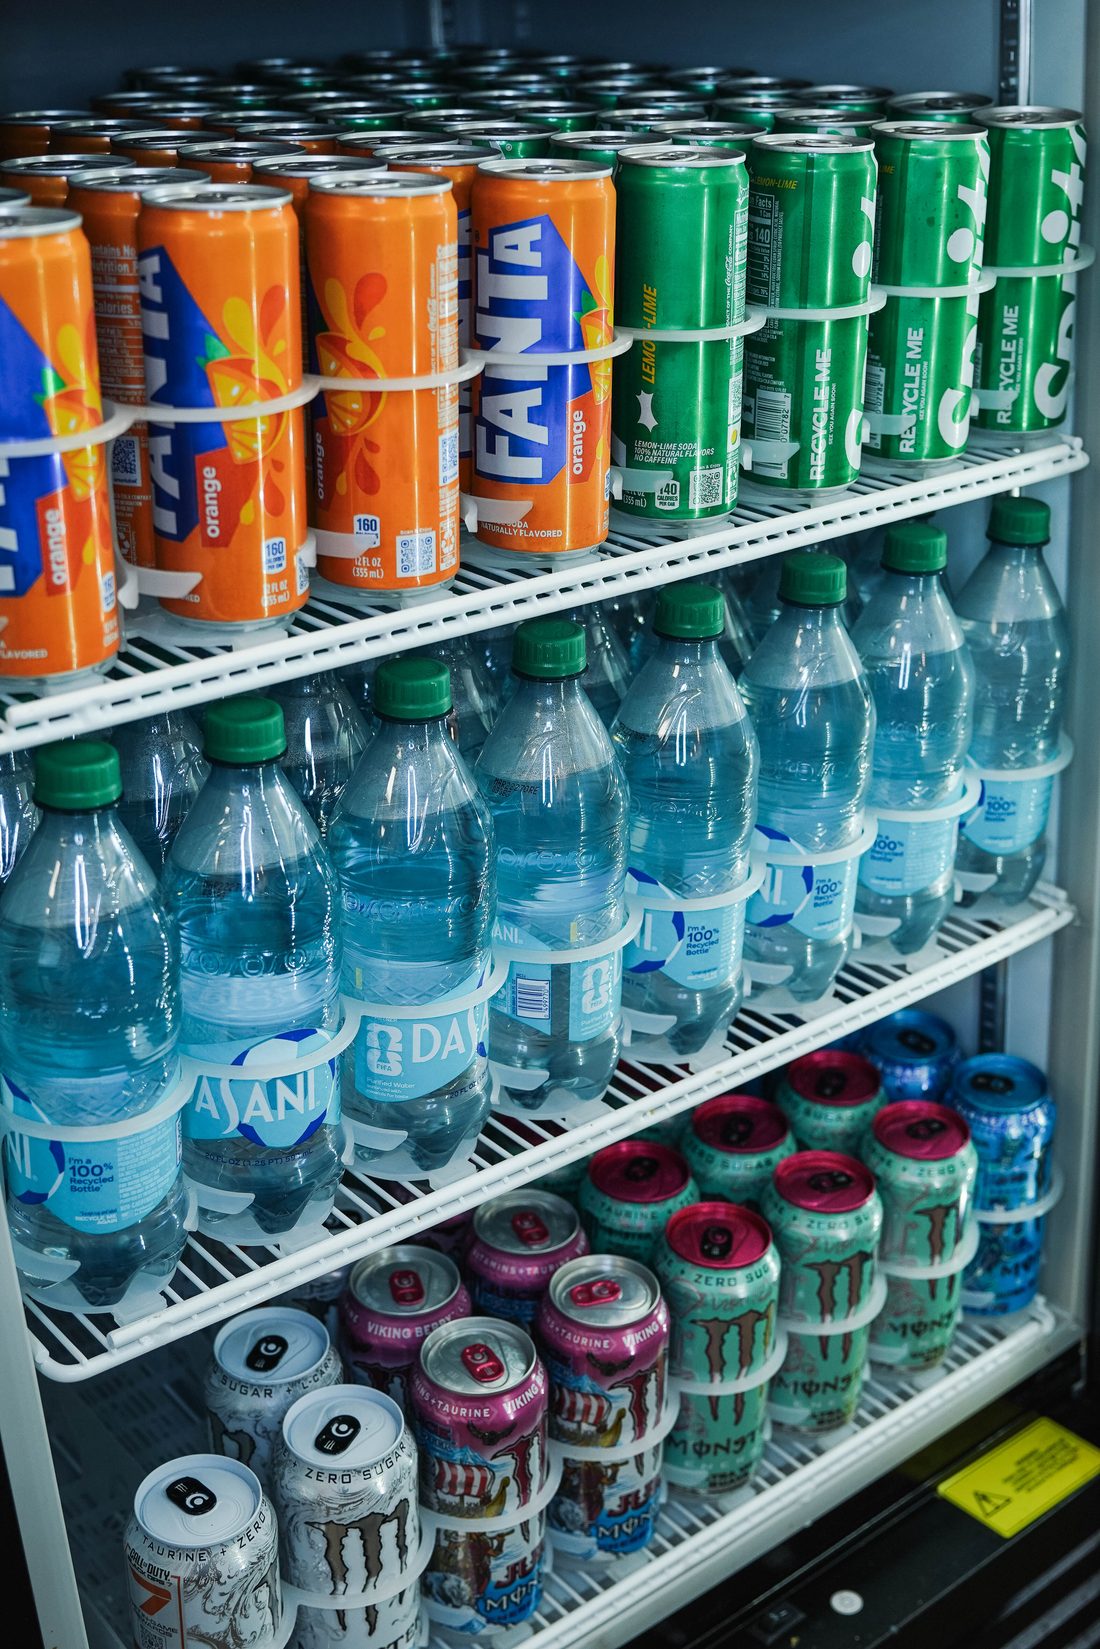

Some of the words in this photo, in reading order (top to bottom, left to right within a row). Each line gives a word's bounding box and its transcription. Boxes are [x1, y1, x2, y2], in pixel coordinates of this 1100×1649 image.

[755, 196, 772, 209] Facts
[755, 229, 770, 243] 140
[1002, 305, 1019, 336] ME
[642, 284, 657, 384] LEMO-LIME
[476, 222, 548, 479] FANTA
[906, 327, 924, 360] ME
[815, 349, 832, 381] ME
[997, 339, 1017, 424] RYCLE
[781, 409, 789, 434] 07782
[573, 410, 586, 475] orange
[810, 387, 830, 480] RECYCLE
[634, 440, 677, 450] LEMON-LIME
[679, 441, 697, 450] SODA
[634, 447, 651, 456] 100%
[651, 450, 683, 458] NATURAL
[315, 432, 325, 499] orange
[644, 456, 677, 464] CAFFEINE
[203, 466, 221, 538] orange
[356, 518, 378, 532] 160
[481, 522, 518, 537] NATURALLY
[519, 529, 563, 538] FLAVORED
[45, 508, 67, 586] orange
[265, 541, 284, 557] 160
[362, 557, 370, 566] FL
[371, 557, 382, 567] OZ
[0, 649, 48, 659] LAVORED
[686, 939, 719, 949] Recycled
[687, 928, 720, 943] 100%
[377, 1063, 392, 1072] FIFA
[393, 1080, 415, 1089] Water
[459, 1086, 468, 1095] FL
[205, 1152, 215, 1160] 20
[216, 1155, 227, 1164] FL
[268, 1156, 284, 1166] PT)
[69, 1162, 114, 1178] 100%
[70, 1175, 114, 1186] Recycled
[70, 1184, 101, 1193] Bottle
[694, 1274, 737, 1287] ZERO
[745, 1263, 769, 1284] SUG
[367, 1321, 411, 1339] VIKING
[561, 1330, 609, 1348] TAURINE
[220, 1375, 273, 1398] SUGAR
[438, 1402, 491, 1418] TAURINE
[503, 1384, 539, 1415] VIKING
[305, 1468, 351, 1485] ZERO
[363, 1442, 406, 1480] SUGAR
[142, 1536, 207, 1562] TAURINE
[237, 1511, 266, 1550] ZERO
[129, 1549, 144, 1570] CALL
